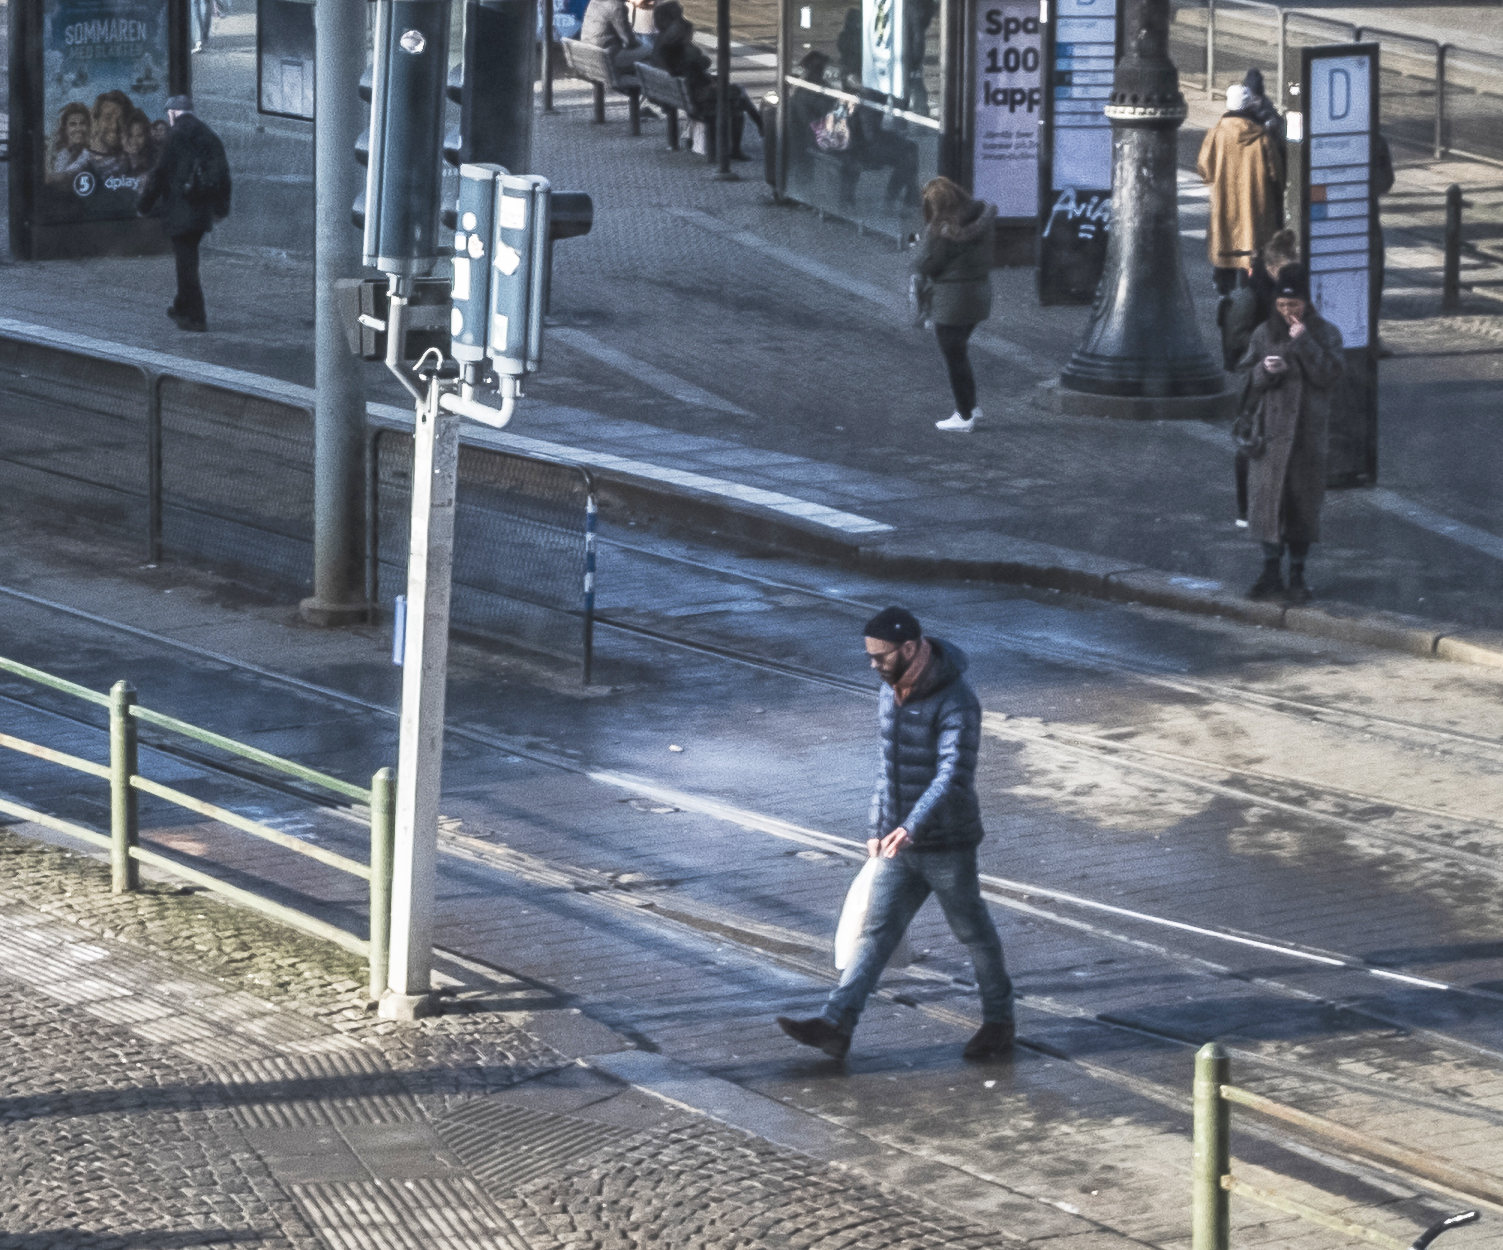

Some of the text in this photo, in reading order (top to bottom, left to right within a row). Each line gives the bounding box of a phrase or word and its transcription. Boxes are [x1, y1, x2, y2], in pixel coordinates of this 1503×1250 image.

[65, 18, 147, 45] SOMMAREN
[984, 47, 1040, 73] 100
[1329, 68, 1351, 120] D
